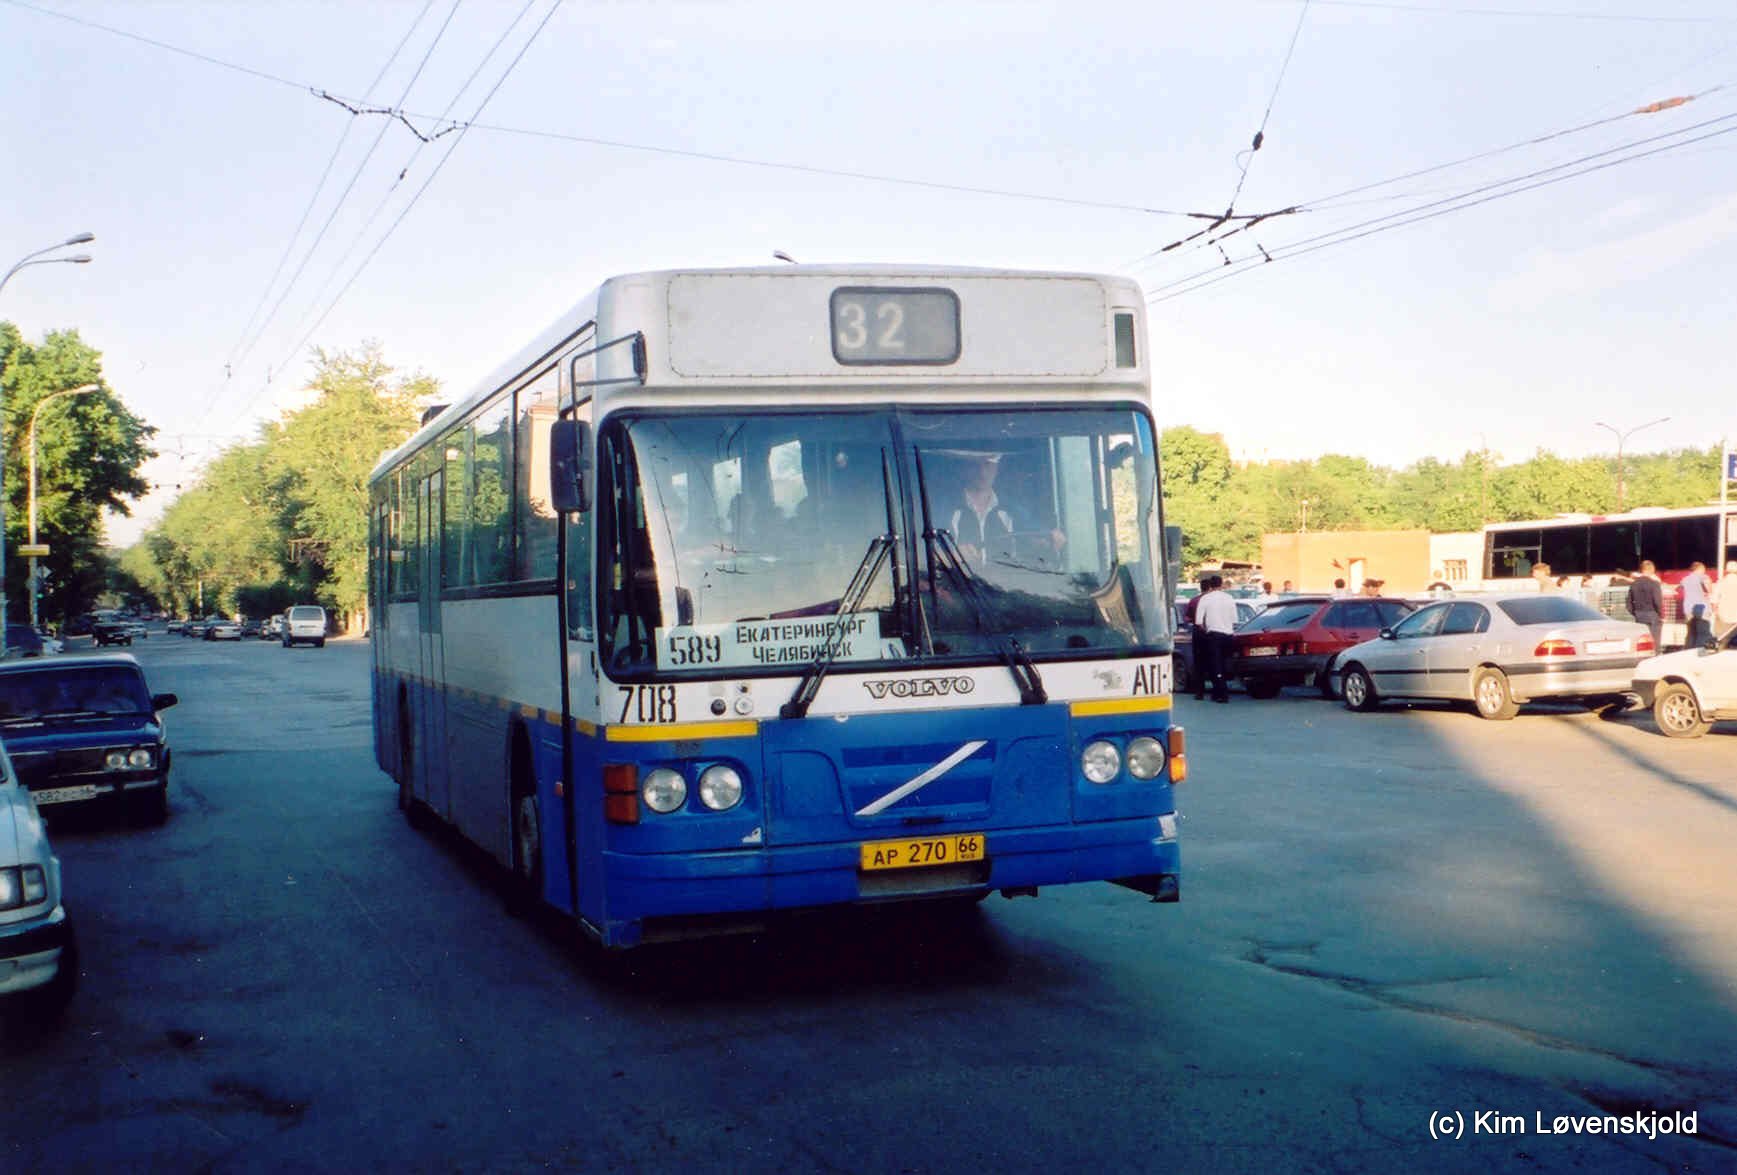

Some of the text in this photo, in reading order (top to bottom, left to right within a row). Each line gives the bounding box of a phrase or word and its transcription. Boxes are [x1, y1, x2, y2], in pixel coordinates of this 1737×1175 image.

[838, 302, 905, 349] 32
[736, 619, 866, 644] ЕКАТЕРИНБУРГ
[670, 635, 721, 664] 589
[752, 641, 853, 664] ЧЕЛЯБИНСК
[863, 676, 975, 699] VOLVO
[618, 684, 676, 723] 708
[909, 841, 946, 863] 270
[958, 837, 978, 853] 66
